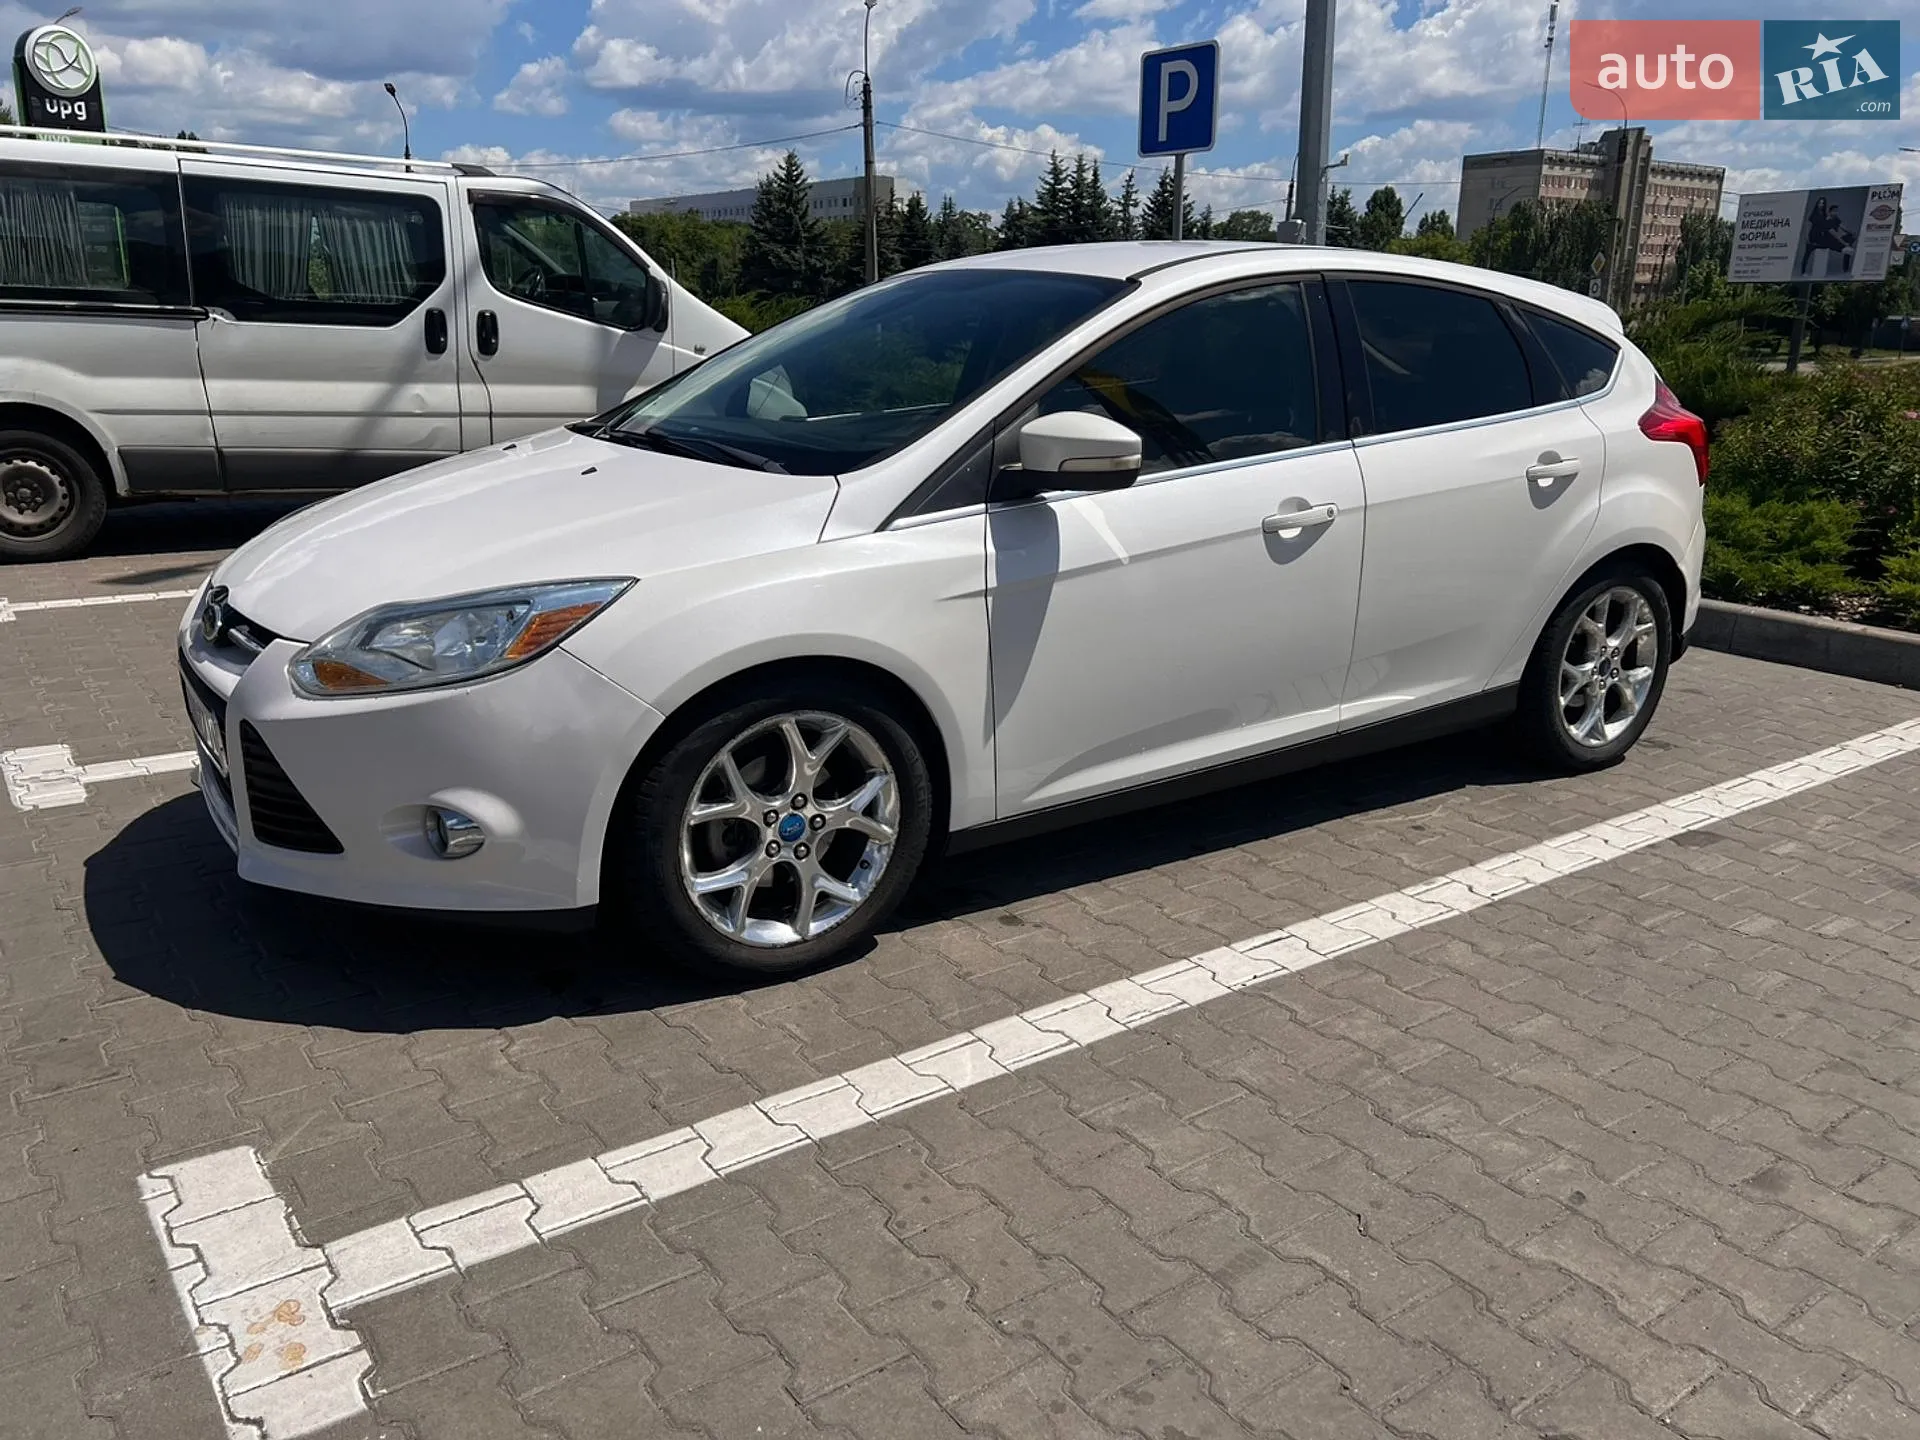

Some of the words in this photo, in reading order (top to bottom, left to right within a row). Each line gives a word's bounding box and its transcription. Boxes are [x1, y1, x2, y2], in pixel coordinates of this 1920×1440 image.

[1158, 59, 1198, 142] P
[45, 99, 87, 121] upg
[1741, 218, 1791, 230] МЕДИЧНА
[1739, 231, 1776, 241] ФОРМА
